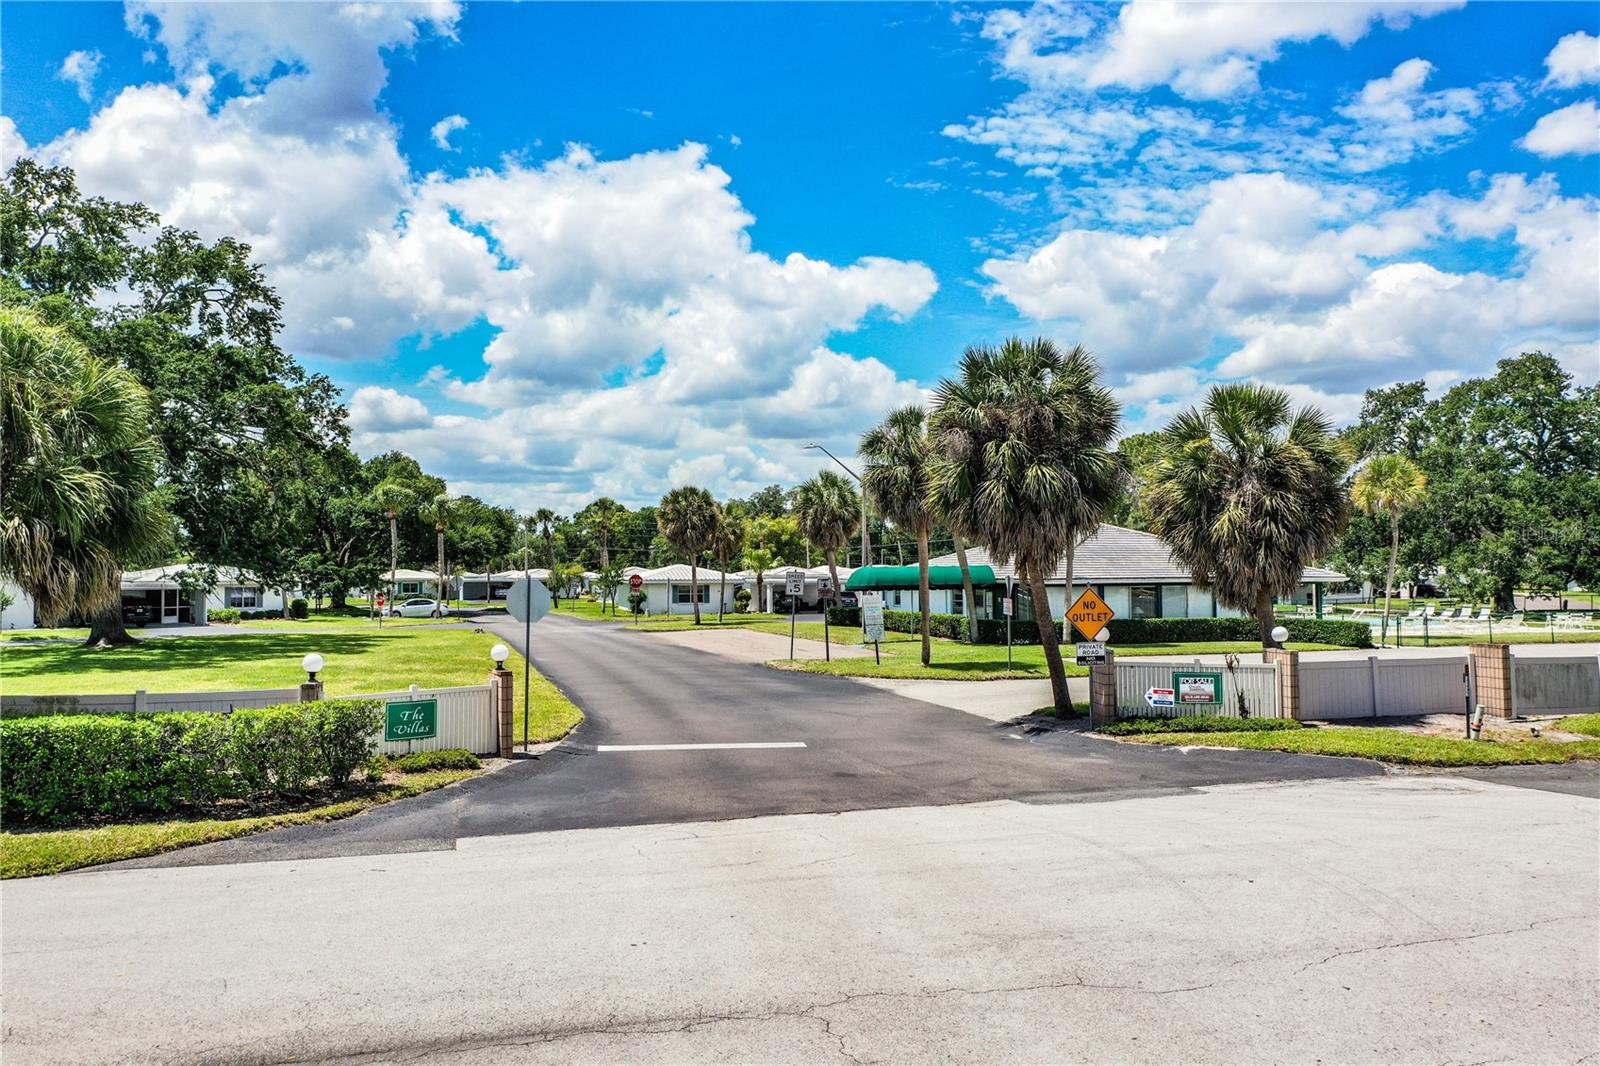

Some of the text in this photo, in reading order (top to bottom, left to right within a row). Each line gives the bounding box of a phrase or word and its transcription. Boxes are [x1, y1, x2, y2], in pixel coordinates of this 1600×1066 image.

[1083, 601, 1096, 610] NO
[1072, 613, 1108, 622] OUTLET
[400, 706, 424, 720] The
[393, 720, 430, 734] Villas
